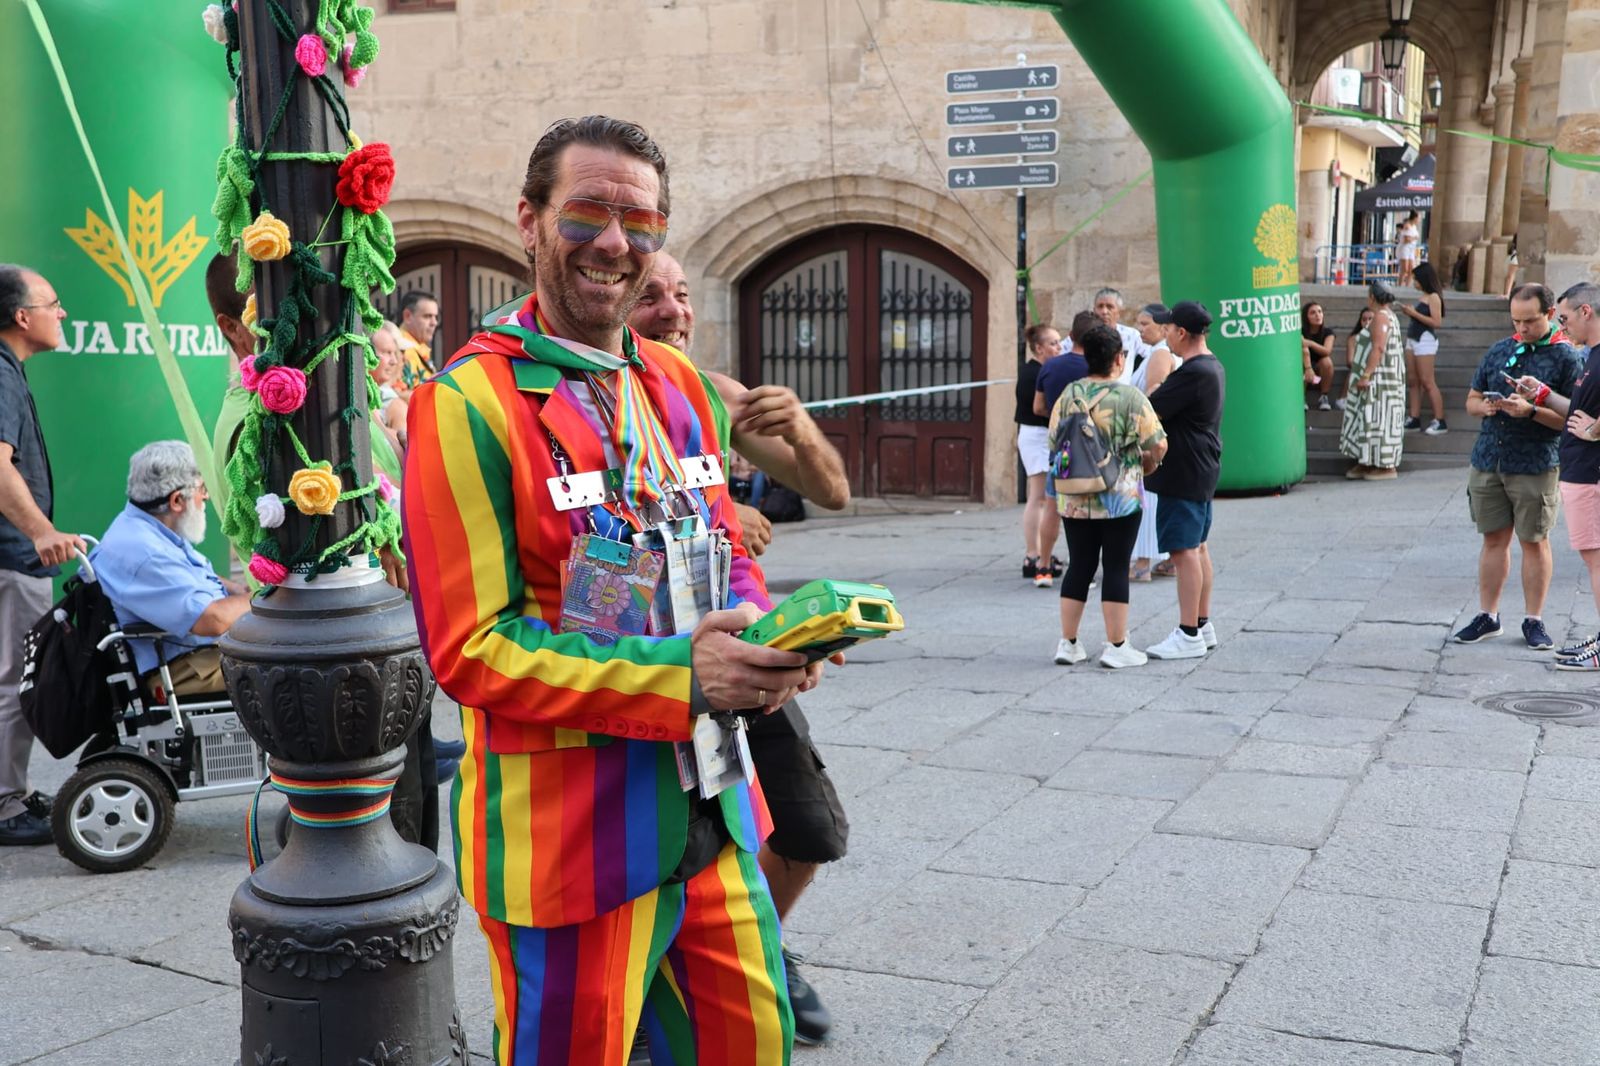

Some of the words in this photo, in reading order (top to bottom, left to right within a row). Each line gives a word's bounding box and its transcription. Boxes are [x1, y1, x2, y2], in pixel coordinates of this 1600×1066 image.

[1375, 196, 1411, 207] Estrella
[1219, 292, 1300, 318] FUNDAC
[54, 320, 120, 355] AJA
[1220, 317, 1276, 338] CAJA
